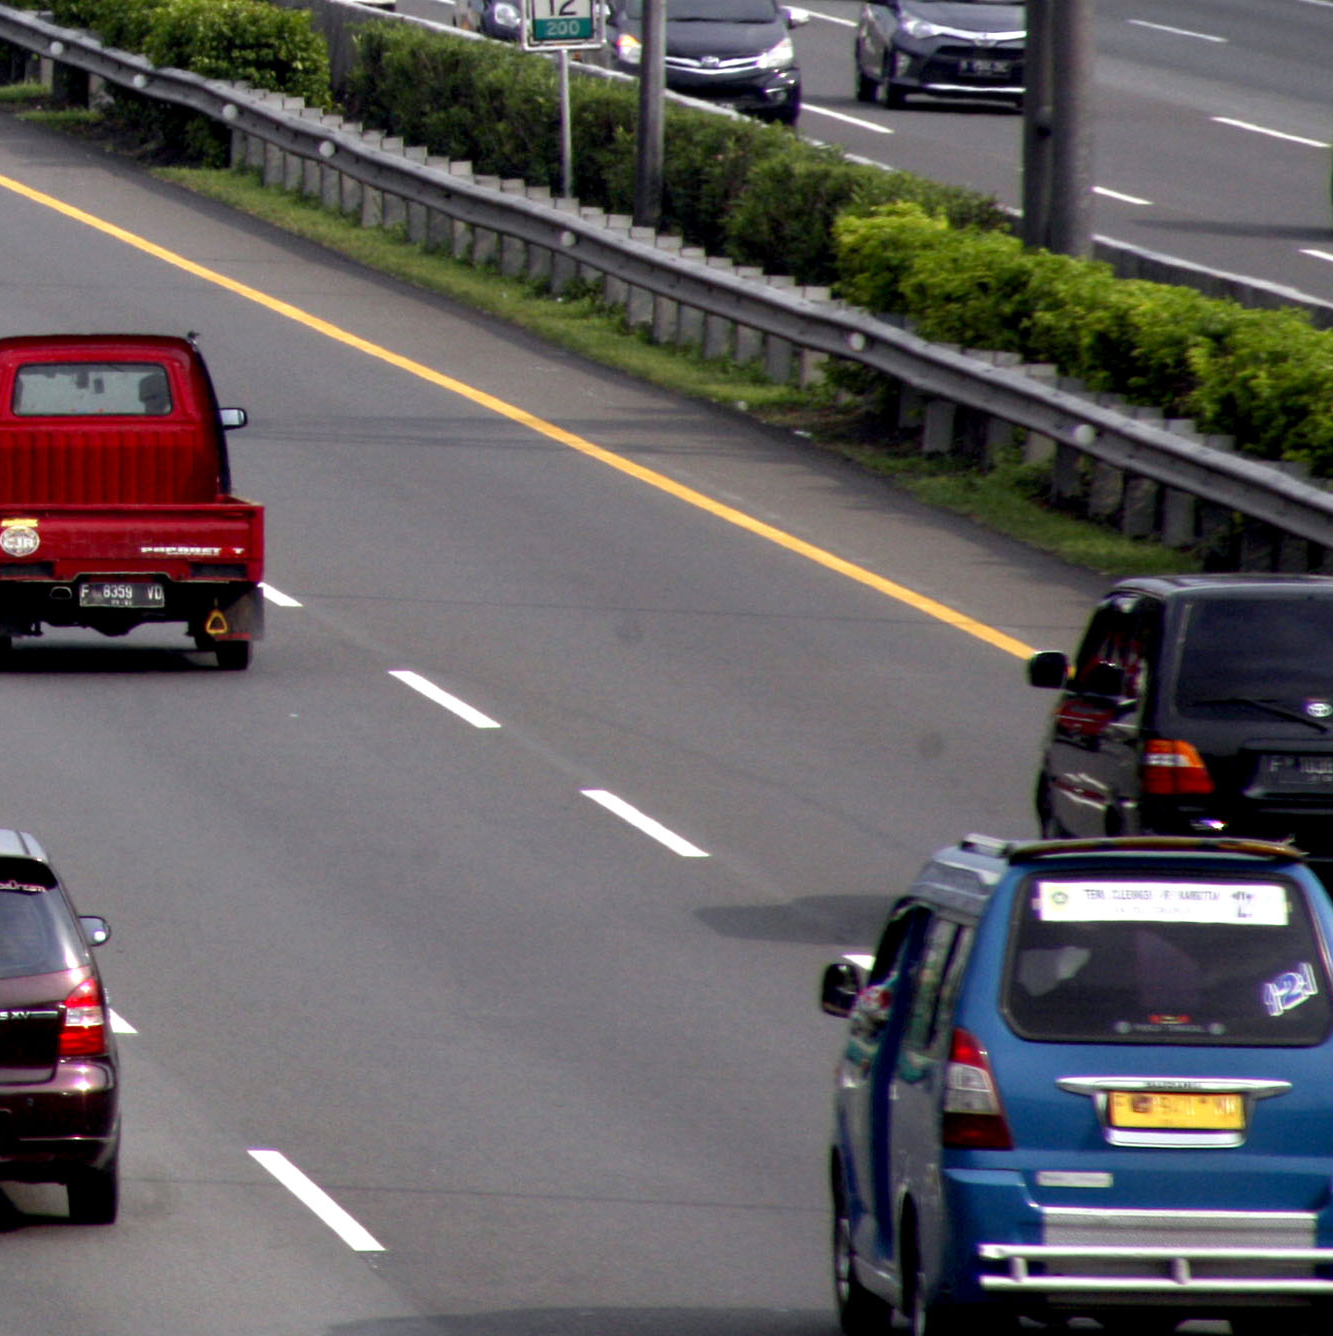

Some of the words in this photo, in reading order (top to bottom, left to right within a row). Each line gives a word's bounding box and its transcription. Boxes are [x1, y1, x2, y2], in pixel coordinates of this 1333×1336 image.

[546, 21, 581, 36] 200
[81, 585, 89, 598] F
[103, 585, 133, 599] 8359
[147, 585, 163, 600] VD
